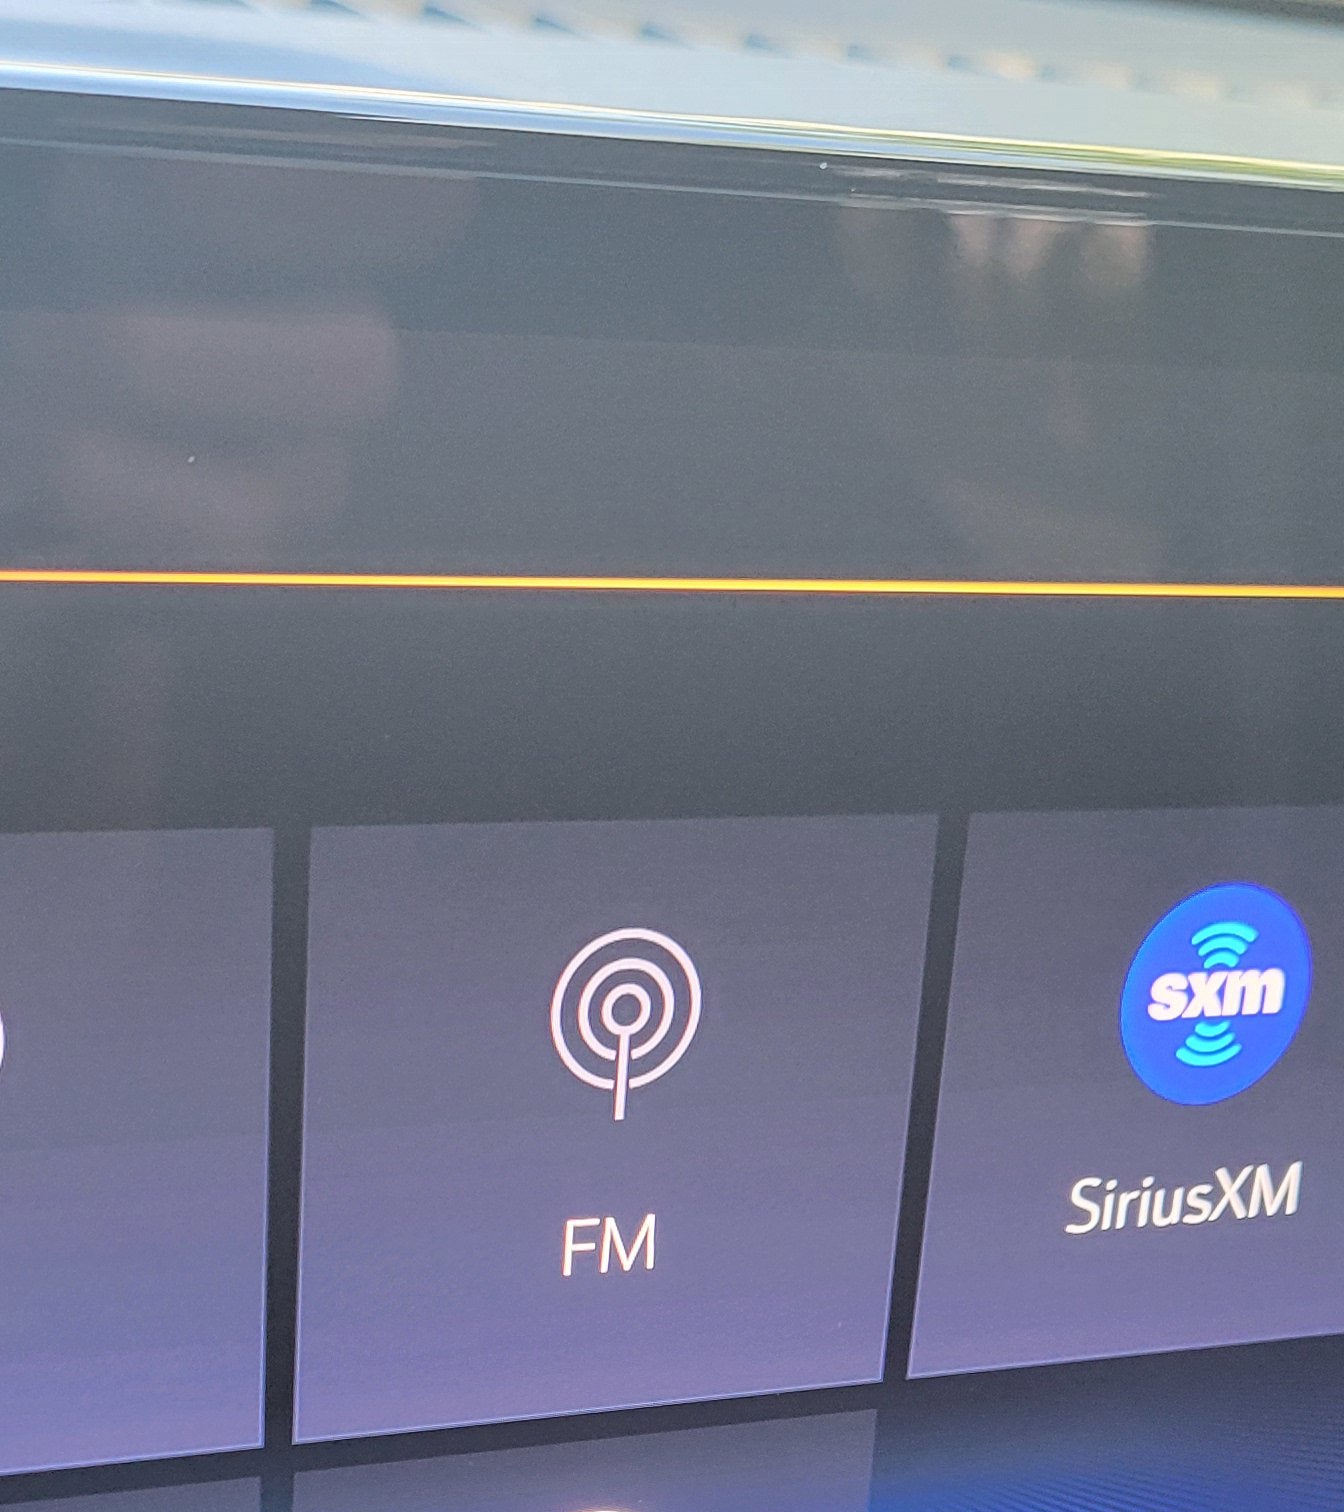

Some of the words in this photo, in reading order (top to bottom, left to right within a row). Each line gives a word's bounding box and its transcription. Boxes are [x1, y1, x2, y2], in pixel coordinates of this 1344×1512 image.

[1146, 967, 1286, 1022] sxm
[1063, 1159, 1304, 1235] SiriusXM
[561, 1212, 656, 1277] FM
